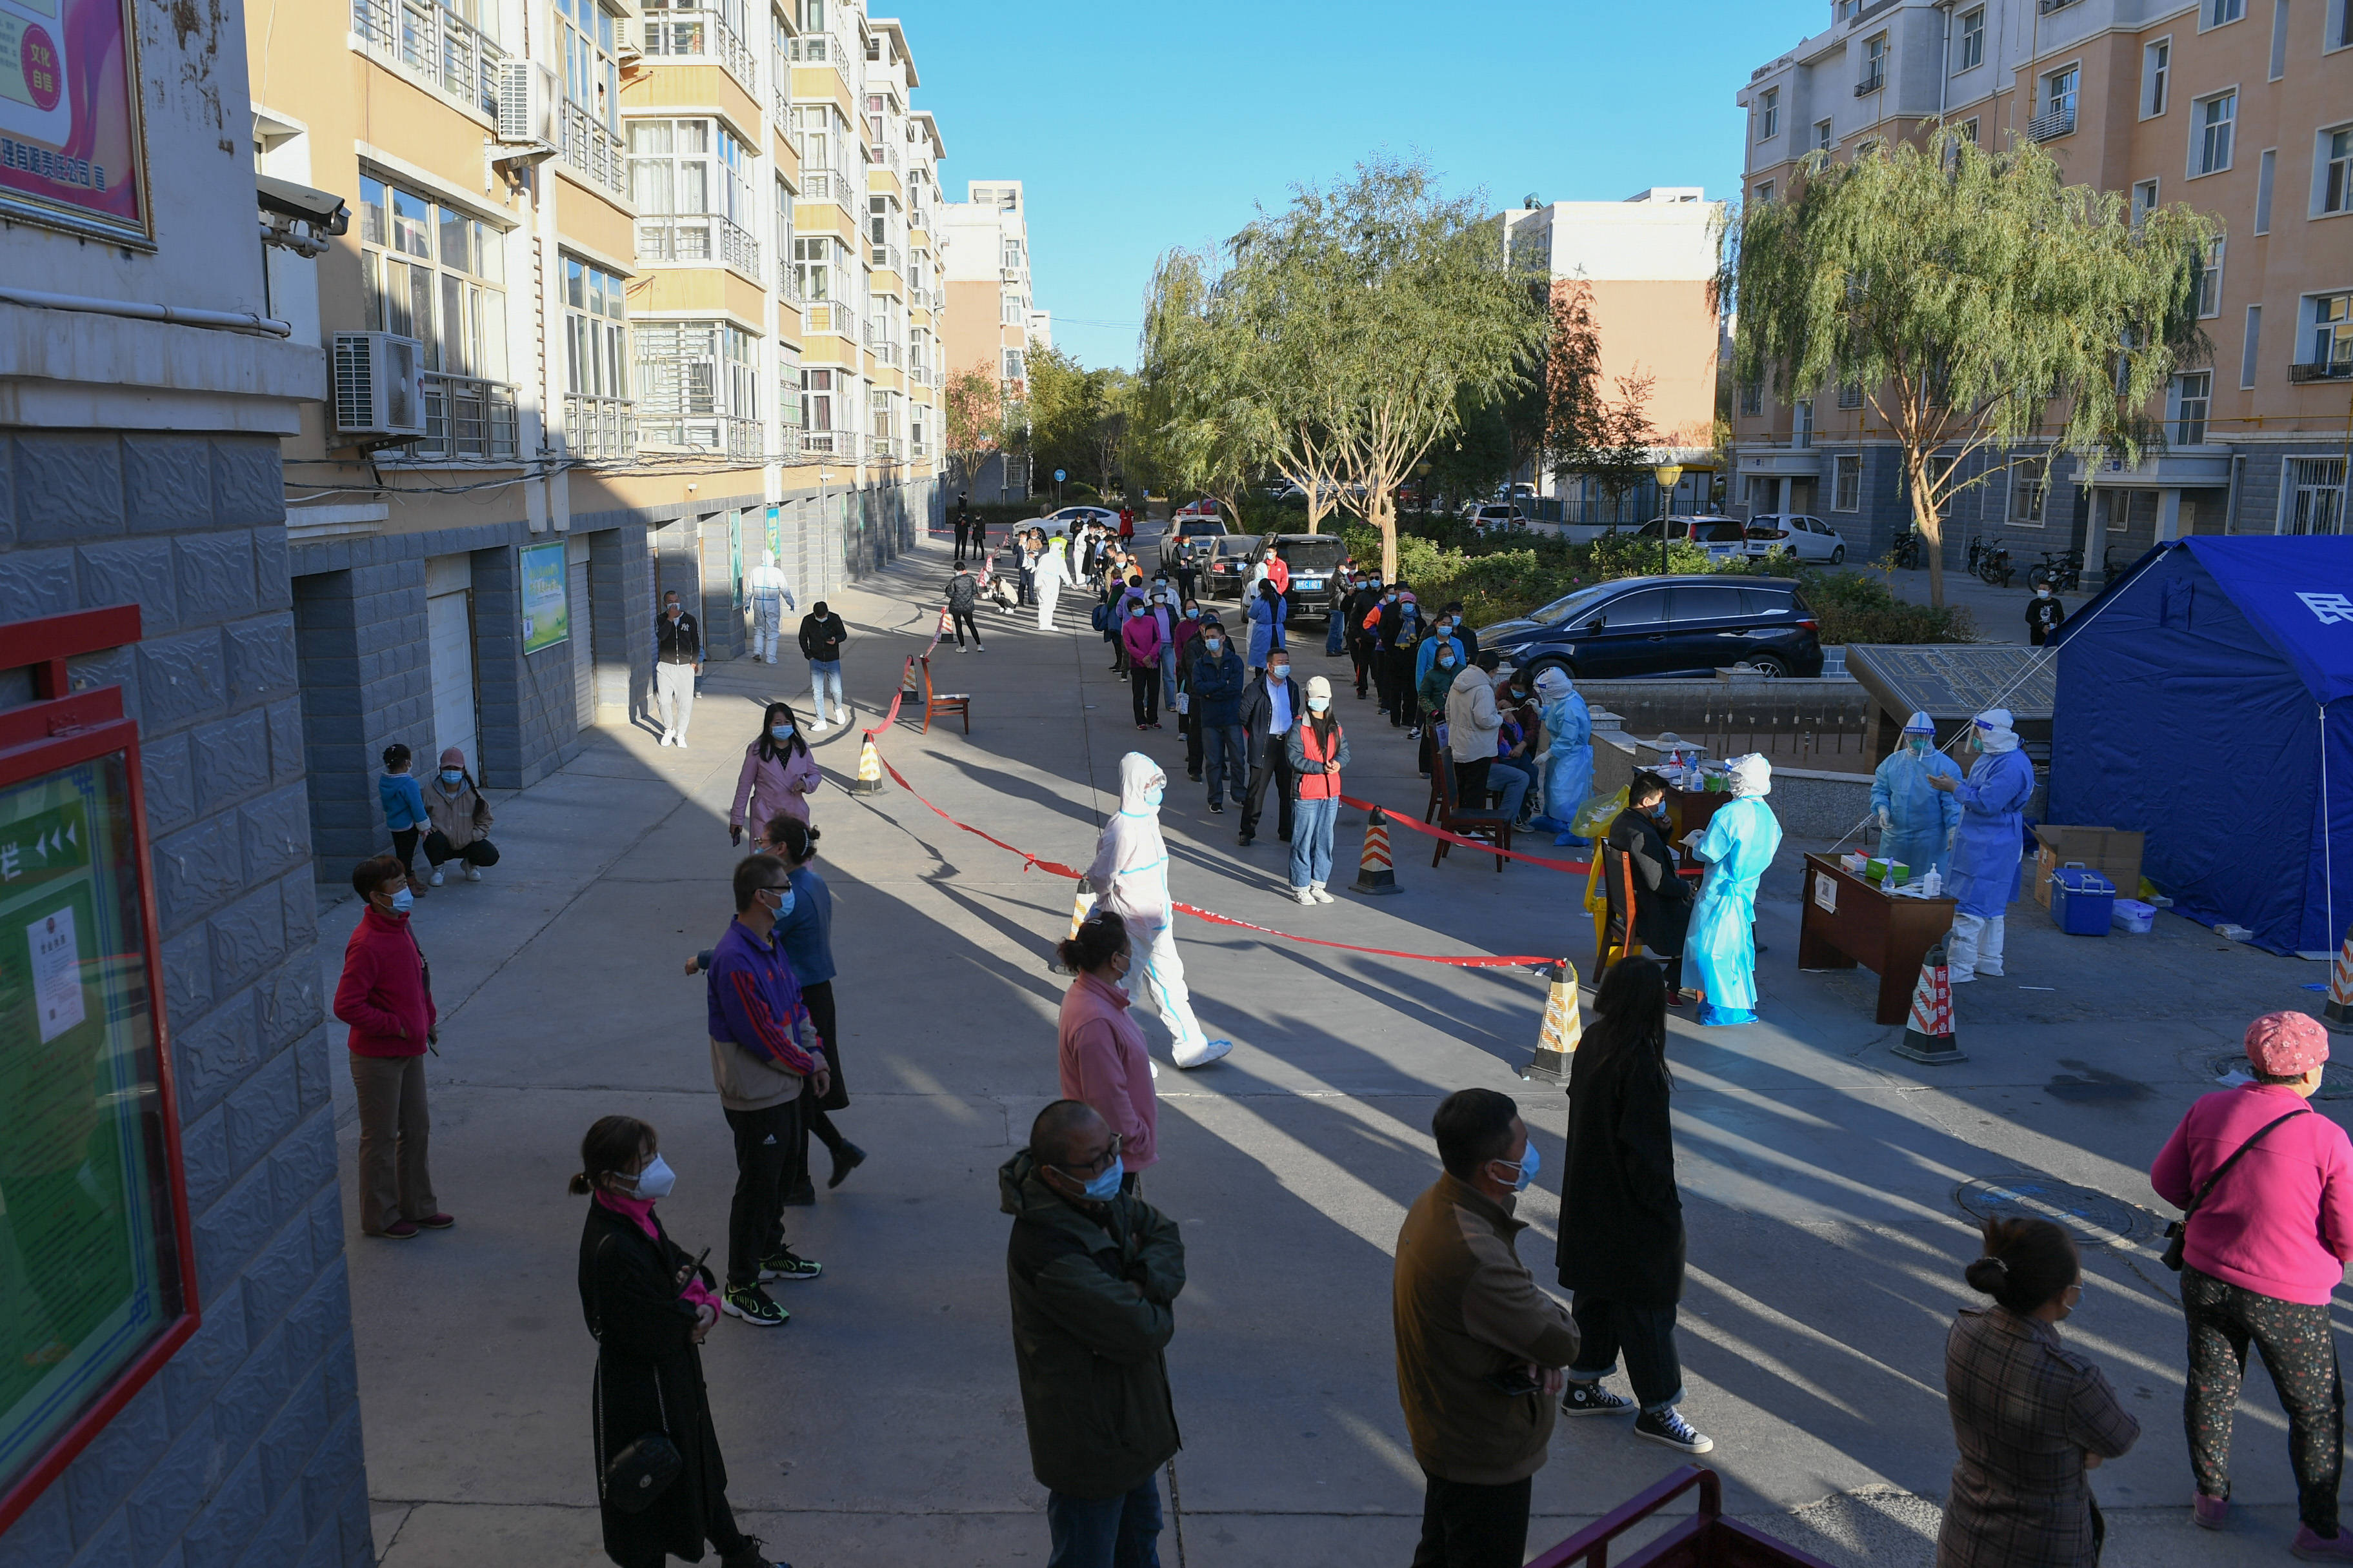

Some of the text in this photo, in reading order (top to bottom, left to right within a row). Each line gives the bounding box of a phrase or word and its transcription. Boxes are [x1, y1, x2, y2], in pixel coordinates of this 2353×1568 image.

[30, 43, 51, 68] 文化
[32, 69, 53, 93] 自信
[94, 165, 106, 193] 宣
[1937, 970, 1947, 1033] 新意物业
